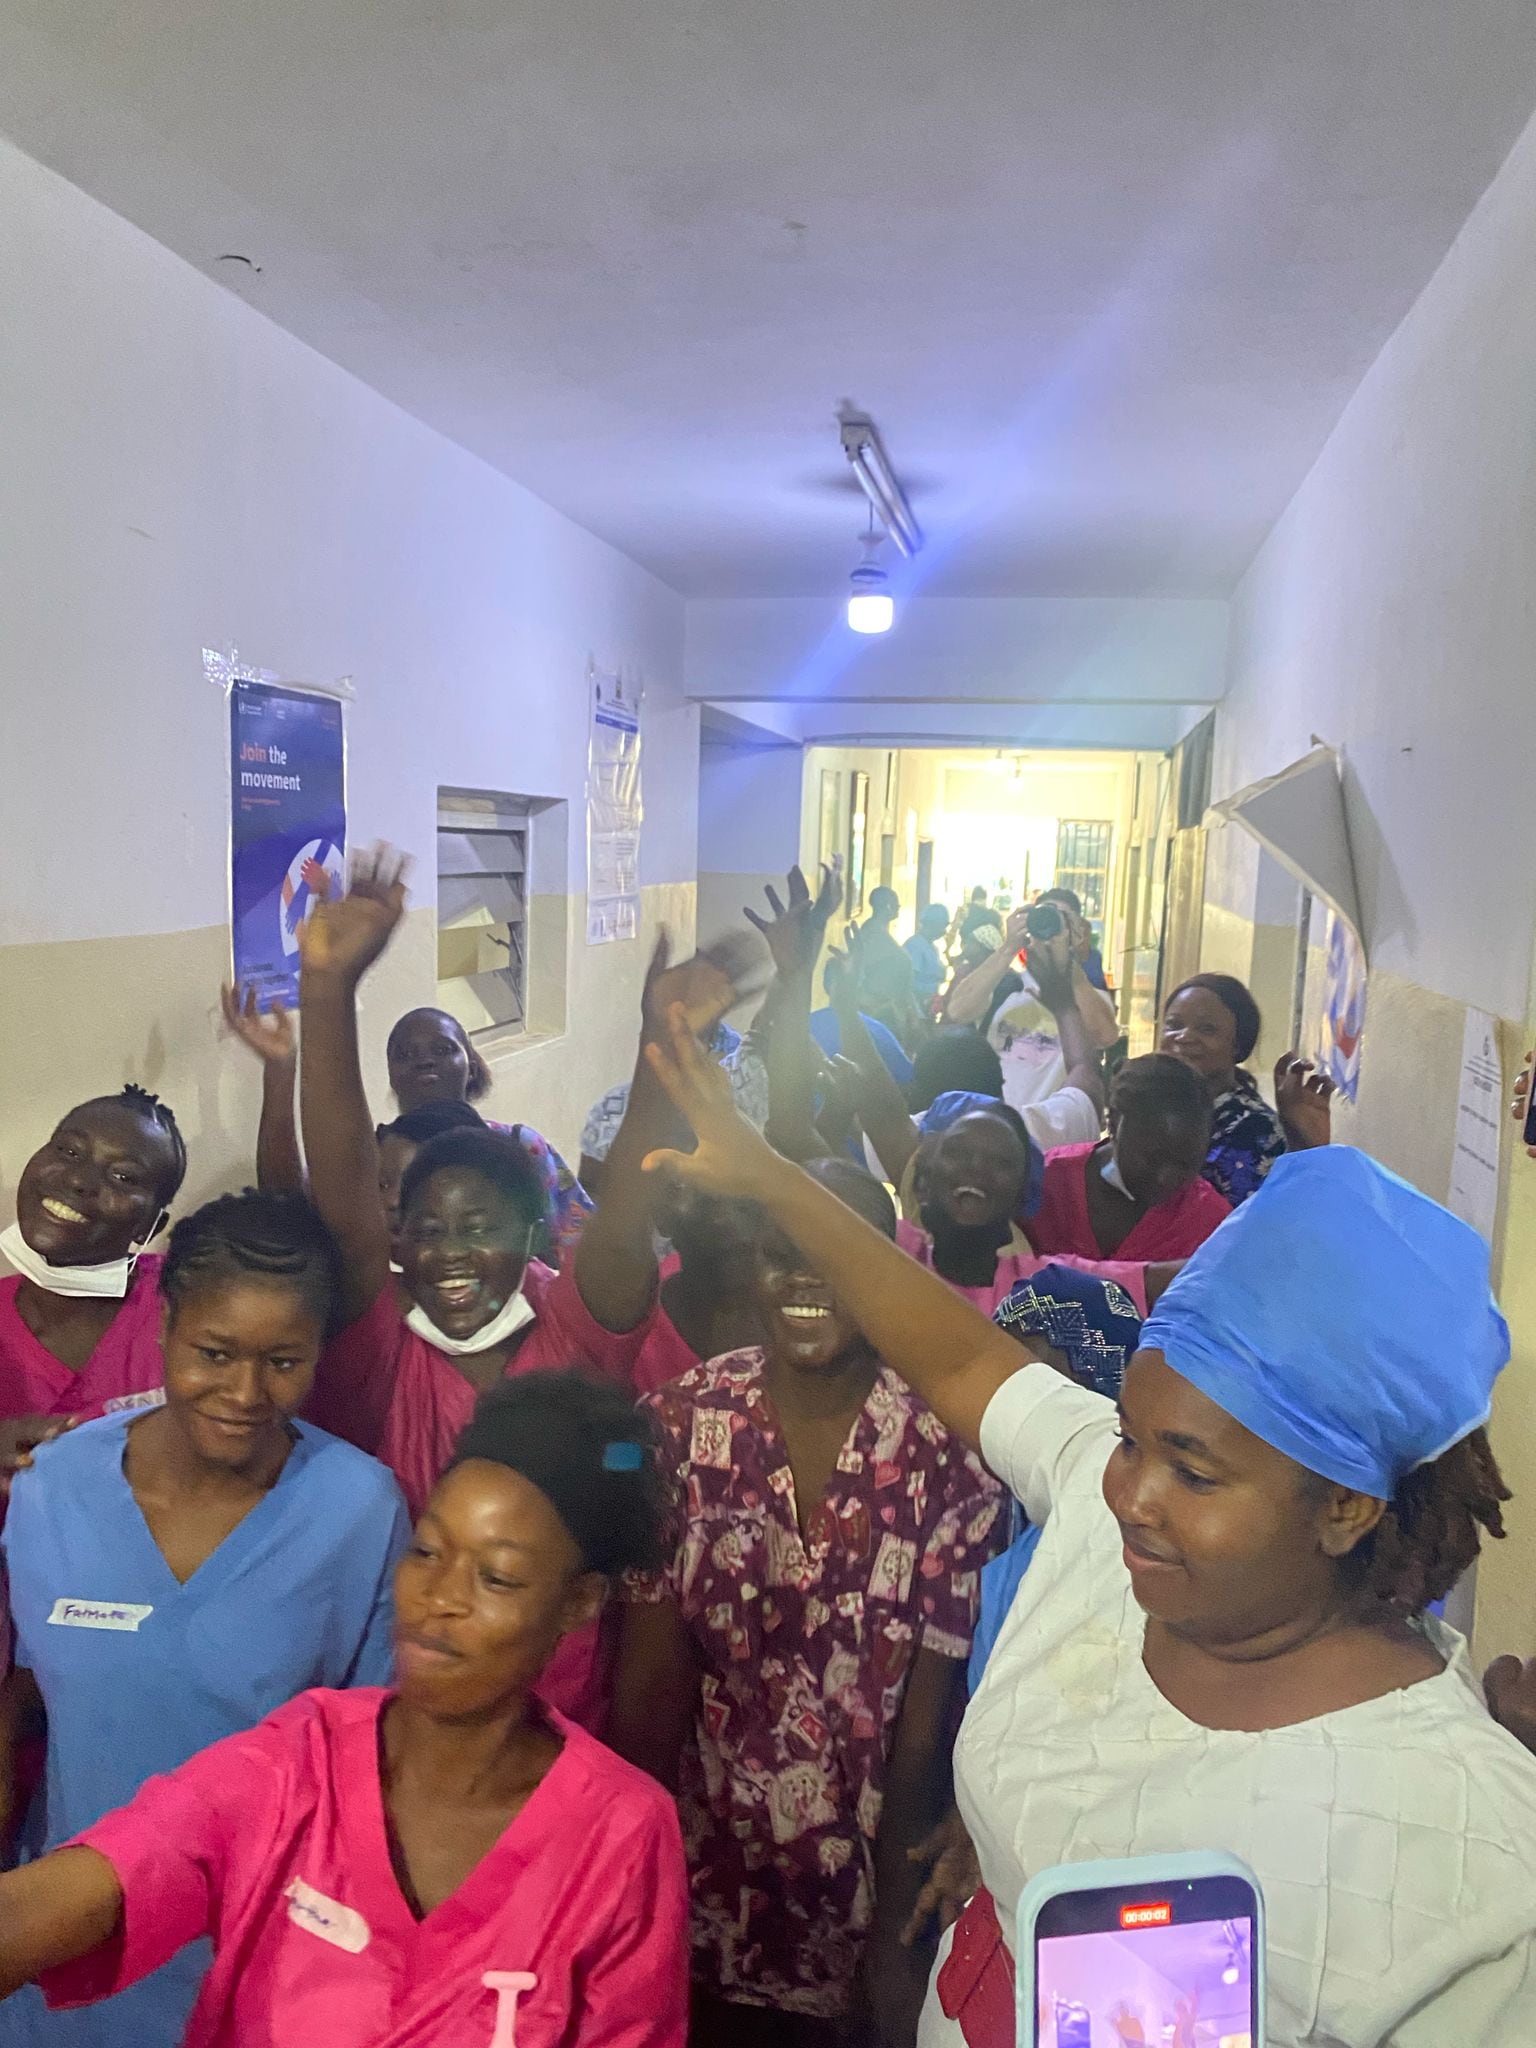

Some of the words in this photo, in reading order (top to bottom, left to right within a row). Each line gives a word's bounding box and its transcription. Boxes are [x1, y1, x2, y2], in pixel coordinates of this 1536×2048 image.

[240, 742, 267, 763] Join
[268, 745, 288, 765] the
[241, 771, 301, 791] movement
[1125, 1909, 1167, 1923] 00:00:02
